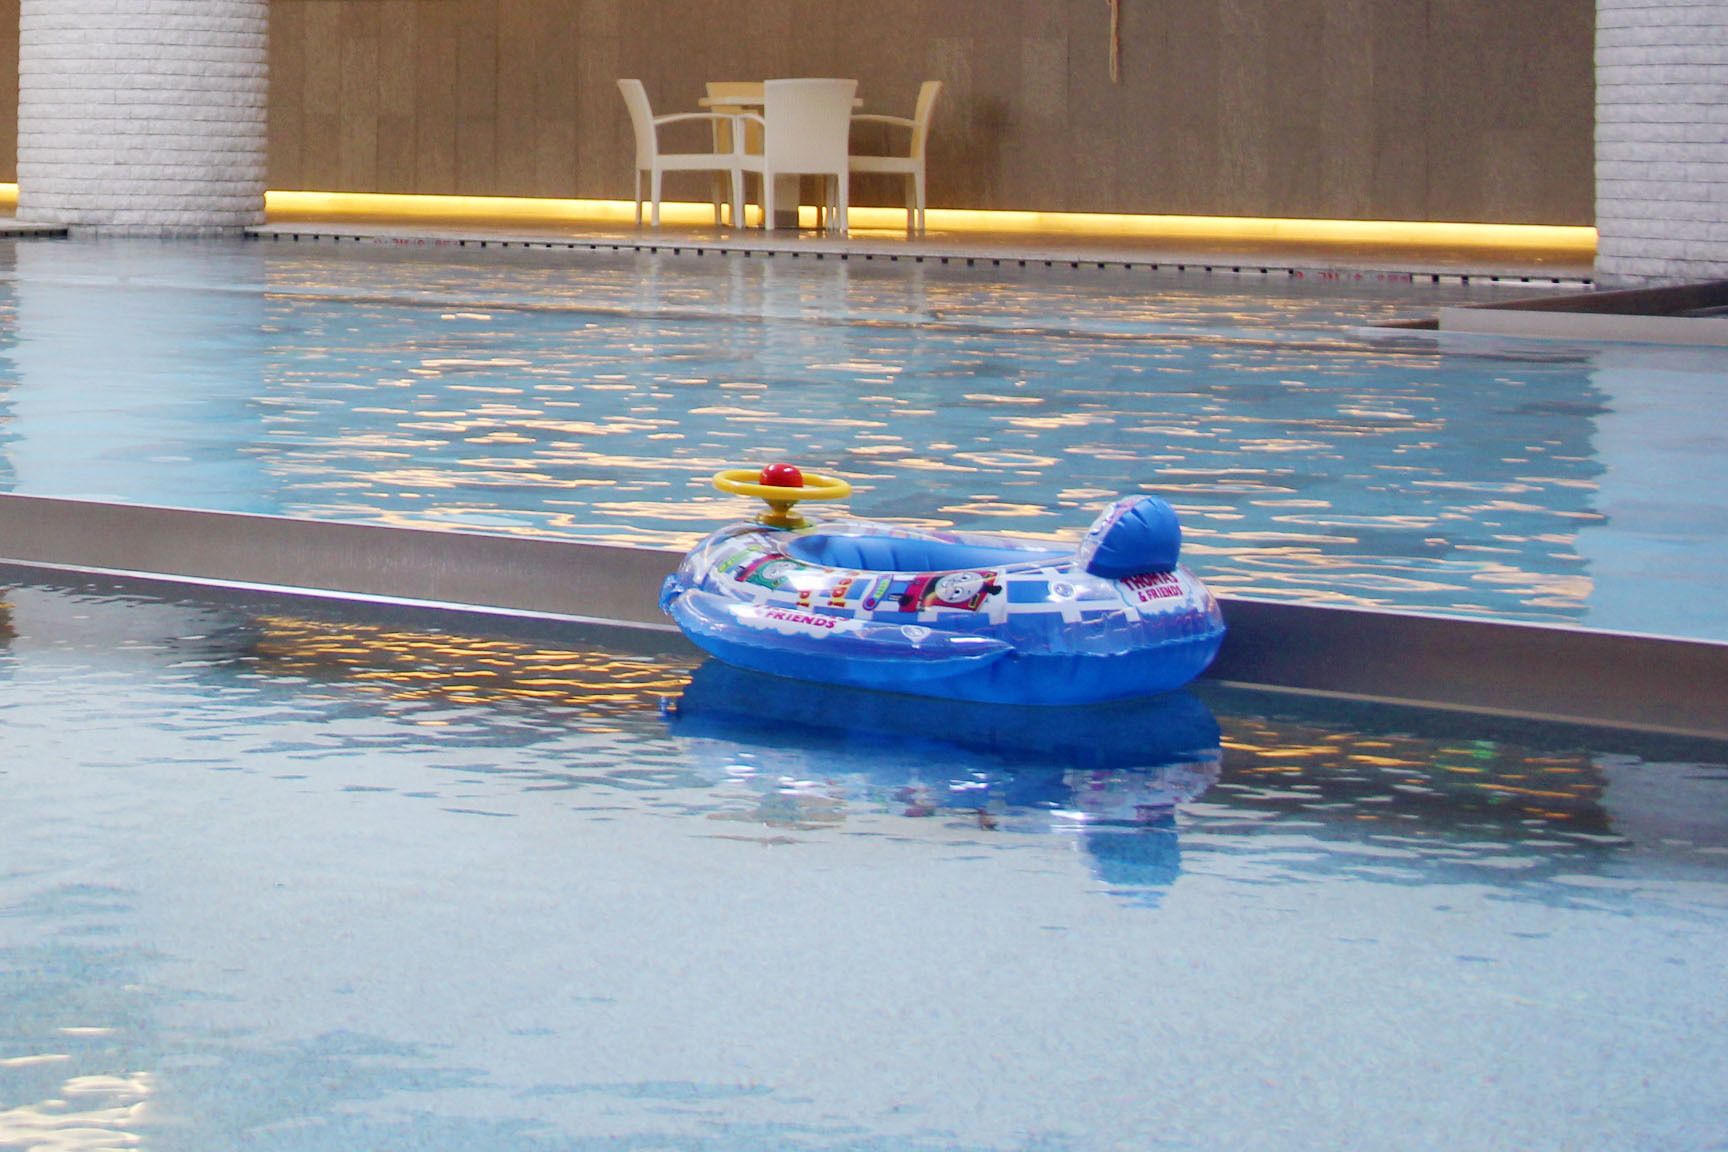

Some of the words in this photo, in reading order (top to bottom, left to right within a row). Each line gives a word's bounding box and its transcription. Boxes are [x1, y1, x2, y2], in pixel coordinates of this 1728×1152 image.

[1120, 571, 1178, 590] THOMAS
[1147, 585, 1183, 599] FRIENDS
[766, 611, 837, 629] FRIENDS
